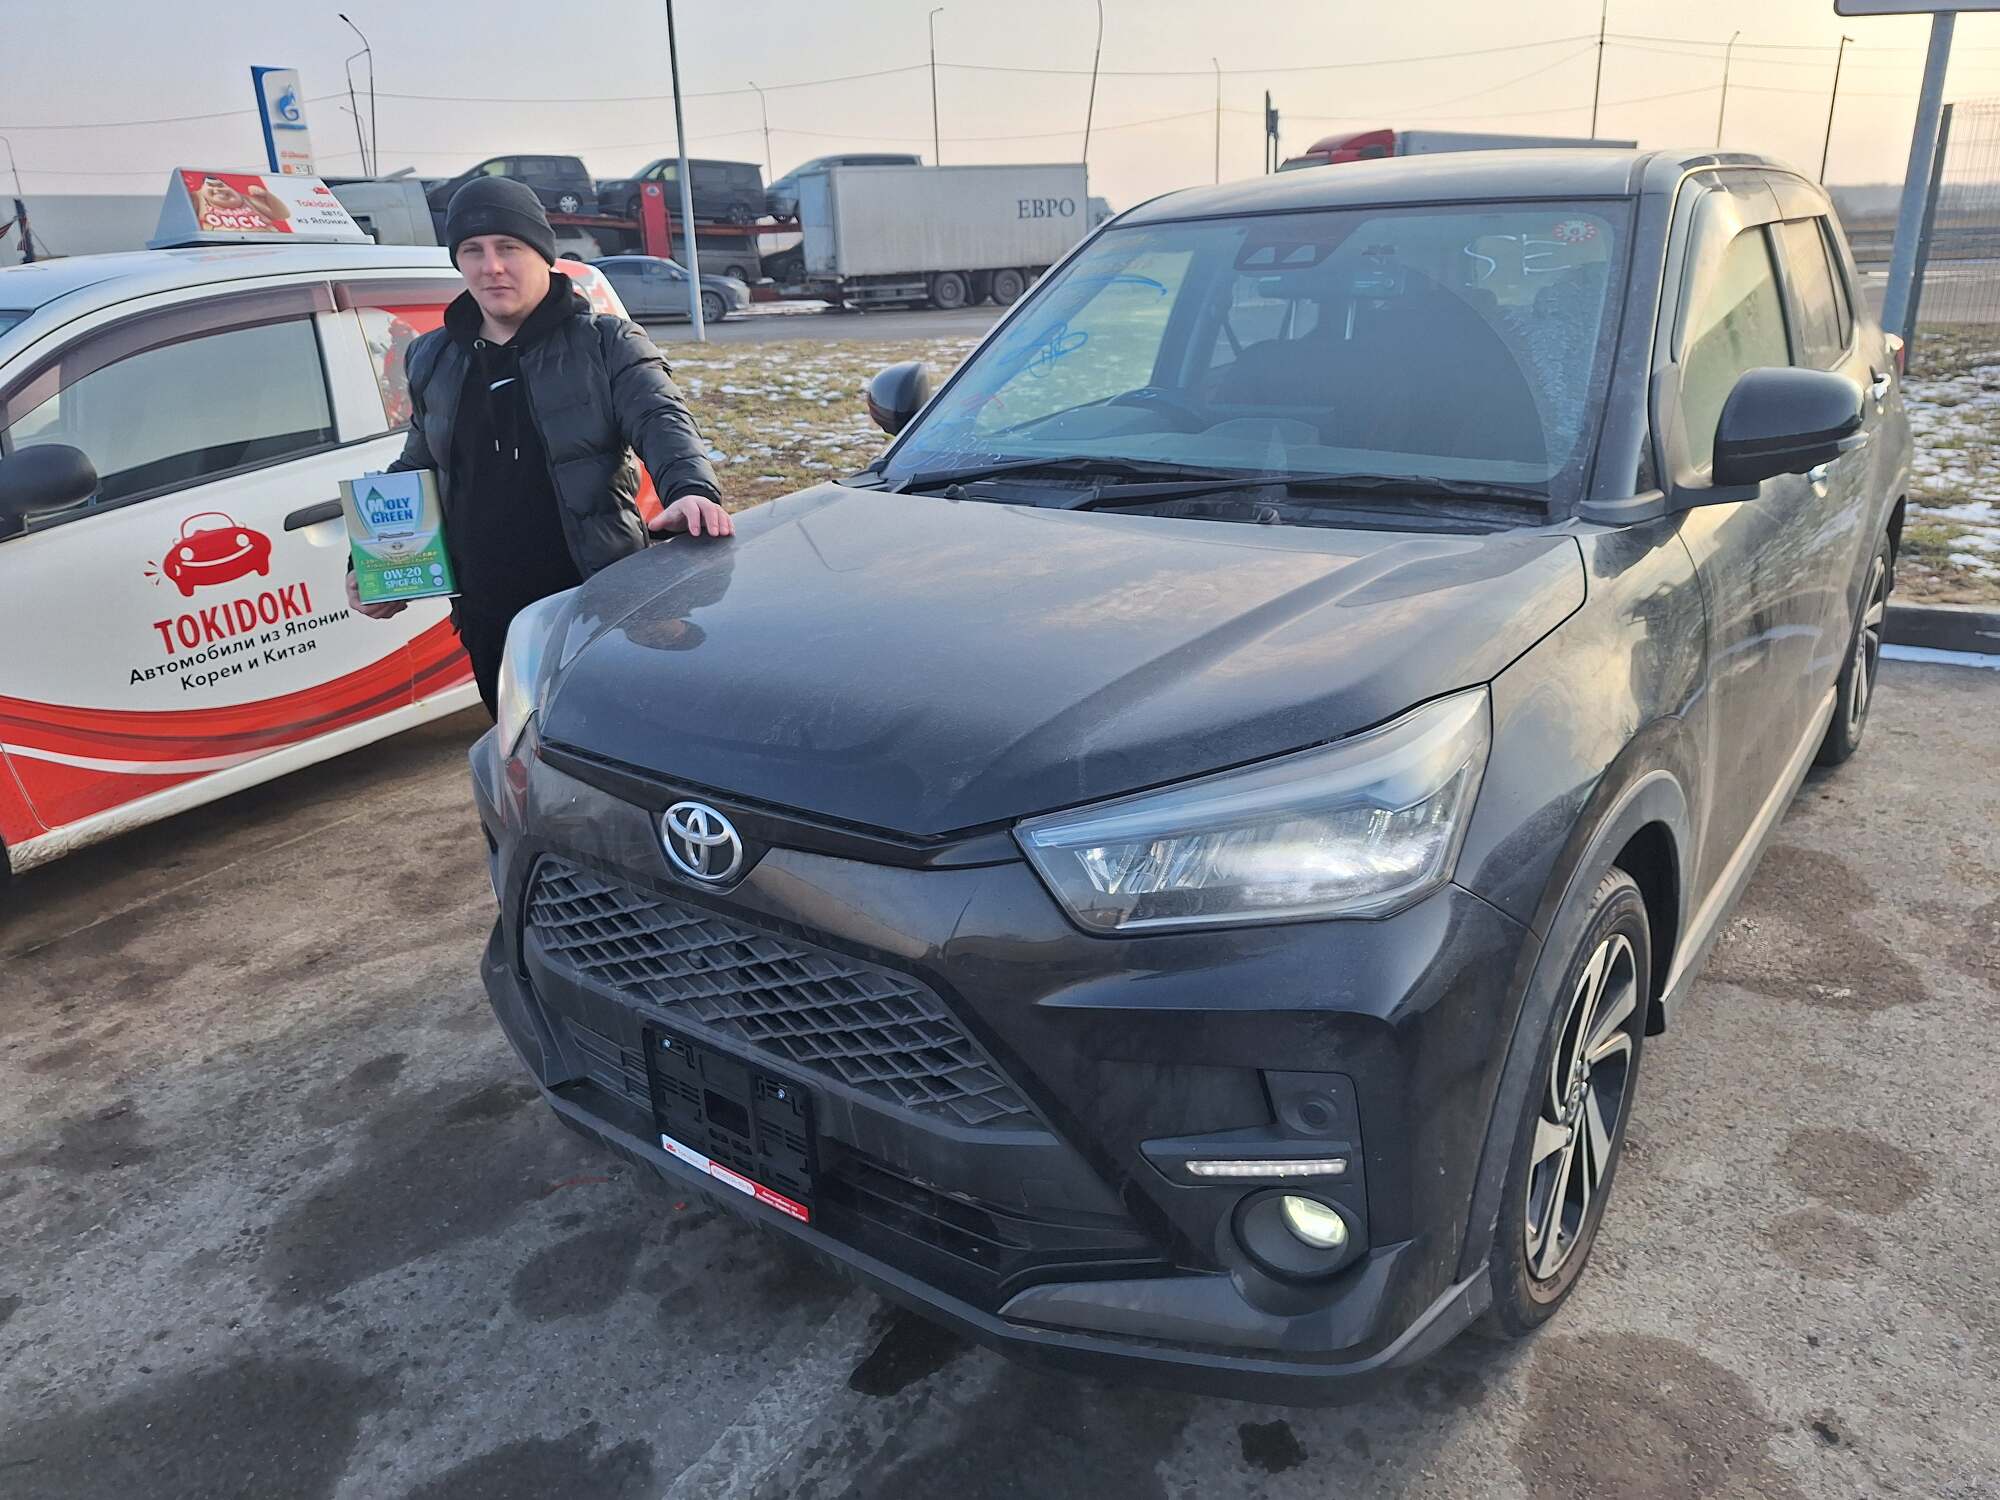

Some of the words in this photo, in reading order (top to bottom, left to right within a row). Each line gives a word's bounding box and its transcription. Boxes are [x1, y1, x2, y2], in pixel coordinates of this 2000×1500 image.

[1016, 198, 1076, 220] ЕВРО
[205, 213, 267, 228] ОМСК
[368, 497, 411, 513] MOLY
[371, 508, 414, 524] GREEN
[153, 582, 313, 655] TOKIDOKI
[129, 638, 256, 686] Автомобили
[260, 631, 281, 645] из
[285, 609, 350, 638] Японии
[180, 663, 243, 691] Кореи
[248, 658, 259, 670] и
[264, 639, 317, 665] Китая
